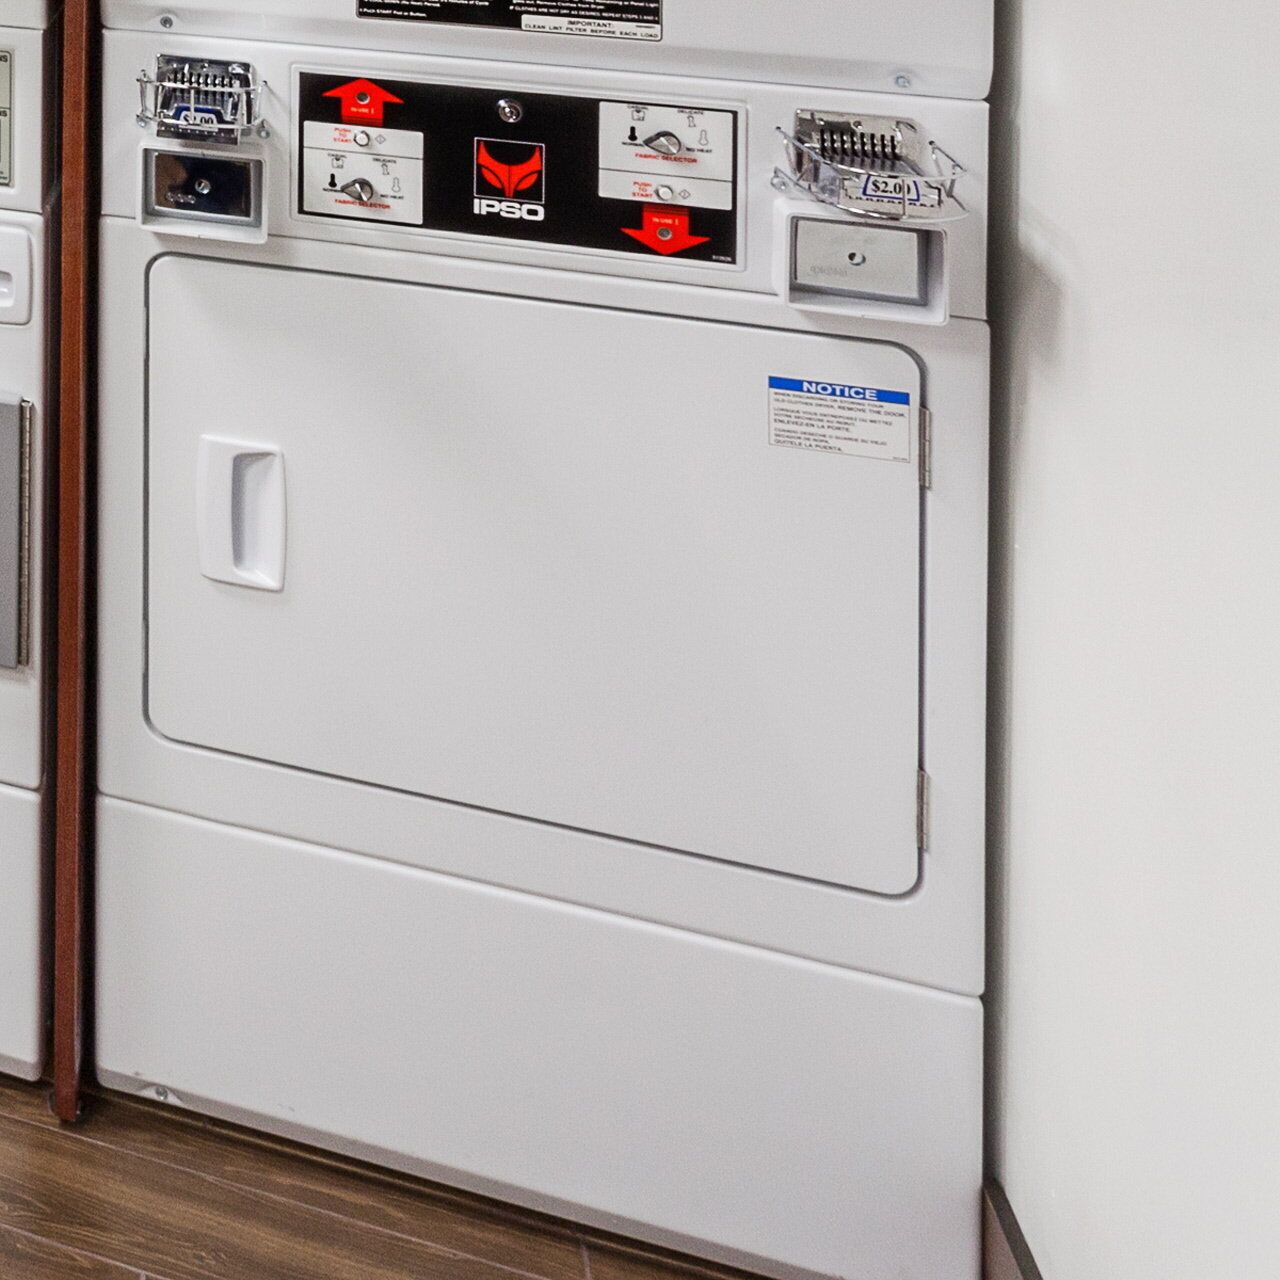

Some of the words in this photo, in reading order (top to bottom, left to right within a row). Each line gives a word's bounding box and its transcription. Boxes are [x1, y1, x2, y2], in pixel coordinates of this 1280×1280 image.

[661, 155, 697, 163] SELECTOR
[359, 201, 391, 209] SELECTOR
[473, 198, 545, 221] IPSO
[803, 381, 878, 400] NOTICE
